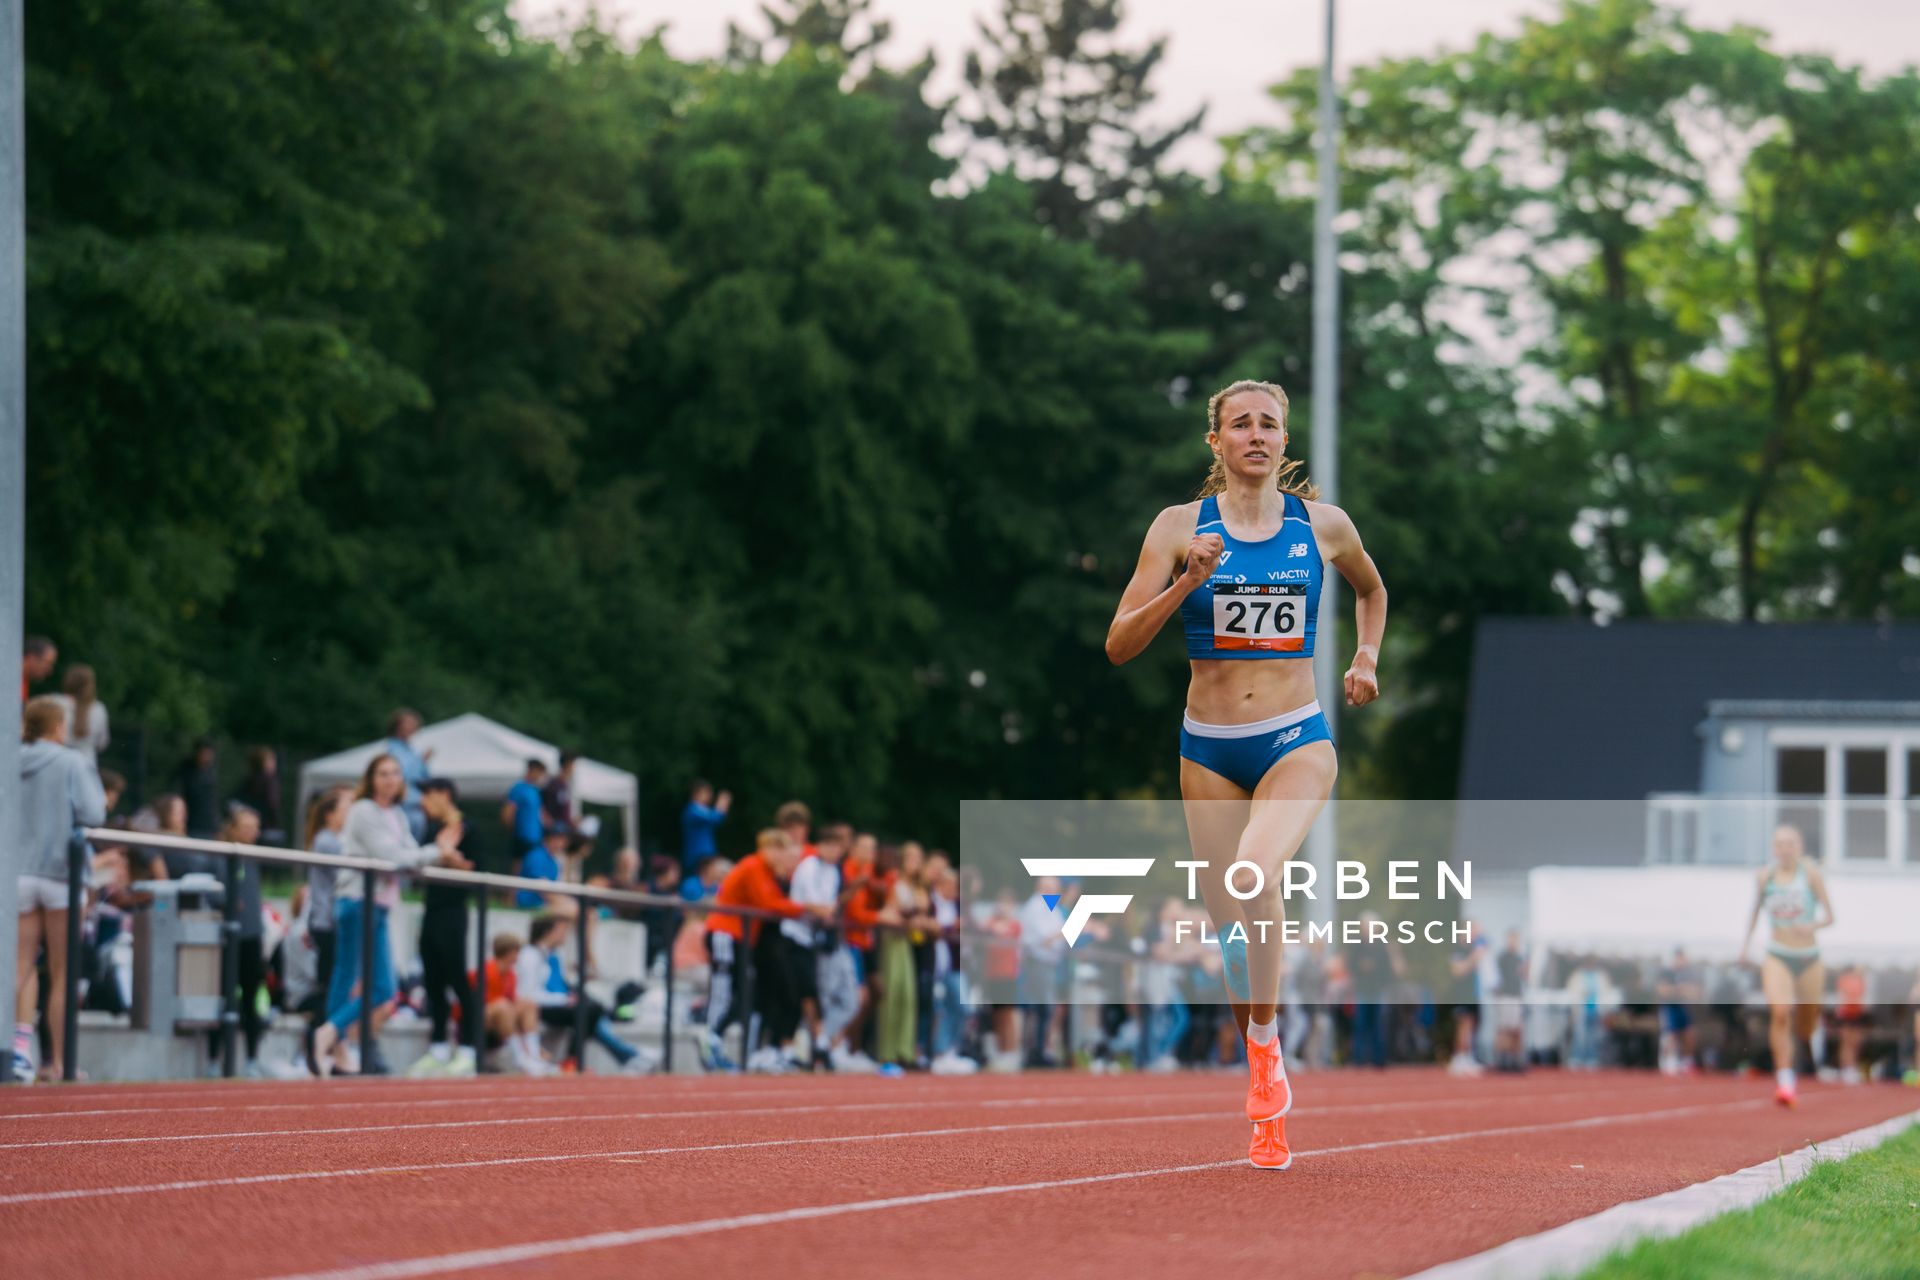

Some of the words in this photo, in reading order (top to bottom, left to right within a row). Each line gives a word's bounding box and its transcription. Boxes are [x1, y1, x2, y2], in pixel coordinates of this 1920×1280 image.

[1287, 543, 1308, 558] NB
[1267, 569, 1310, 581] VIACTIV
[1234, 586, 1260, 594] JUMP
[1261, 586, 1268, 594] N
[1268, 586, 1289, 594] RUN
[1225, 601, 1295, 634] 276
